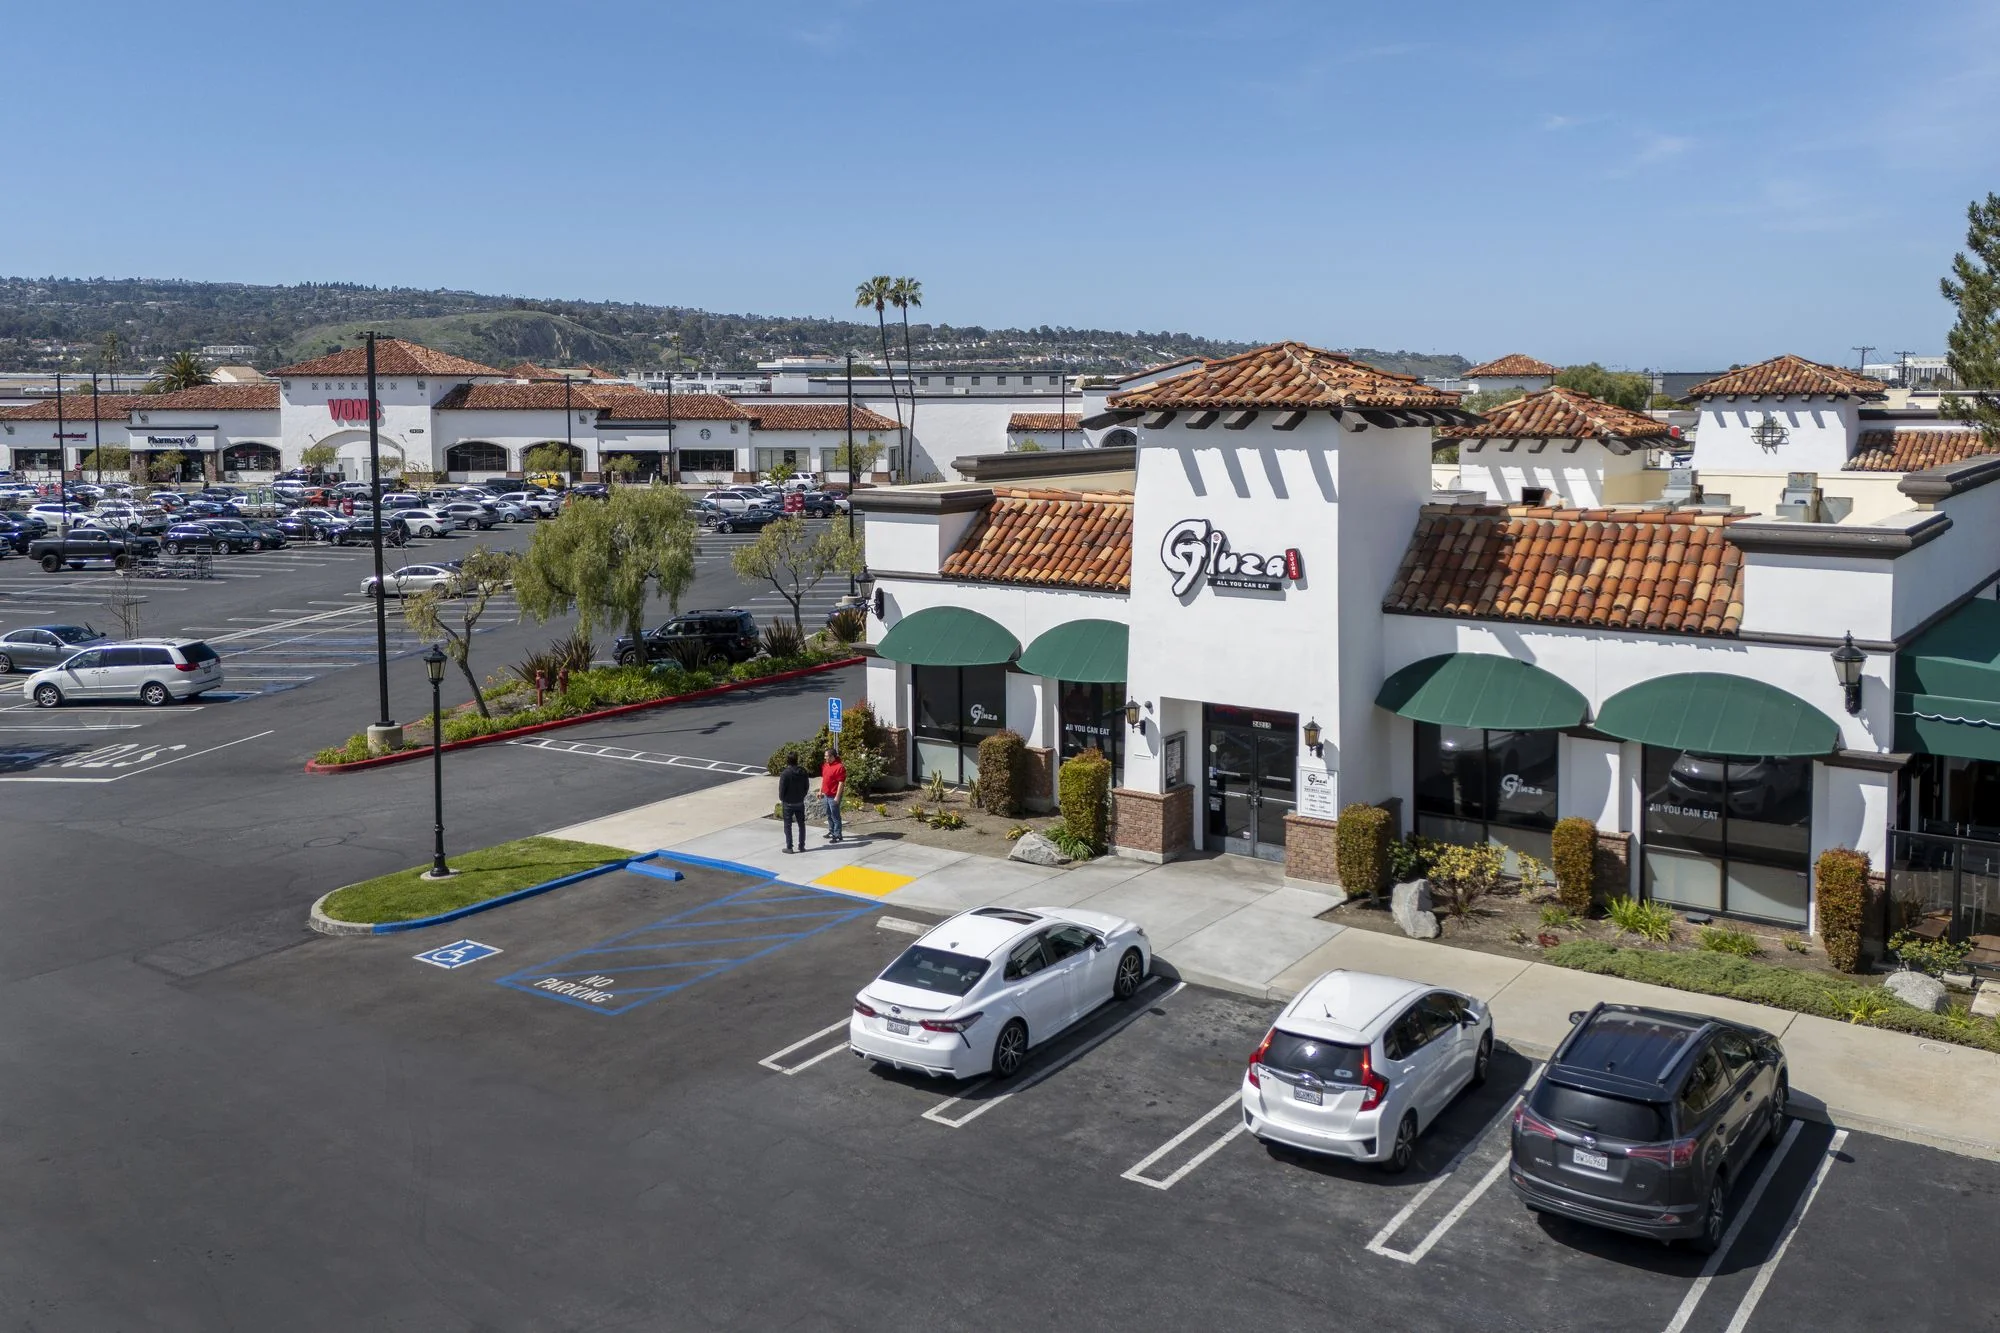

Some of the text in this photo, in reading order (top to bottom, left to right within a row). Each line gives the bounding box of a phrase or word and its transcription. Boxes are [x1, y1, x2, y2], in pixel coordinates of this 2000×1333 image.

[148, 436, 184, 446] Pharmacy
[1161, 519, 1288, 597] Ginza
[970, 704, 998, 724] Ginza
[1074, 724, 1086, 733] YOU
[1087, 726, 1098, 734] CAN
[1100, 727, 1110, 735] EAT
[1501, 774, 1542, 799] Ginza
[1663, 805, 1680, 815] YOU
[1683, 807, 1700, 817] CAN
[1703, 810, 1719, 820] EAT
[580, 975, 614, 987] NO
[533, 977, 614, 1003] PARKING
